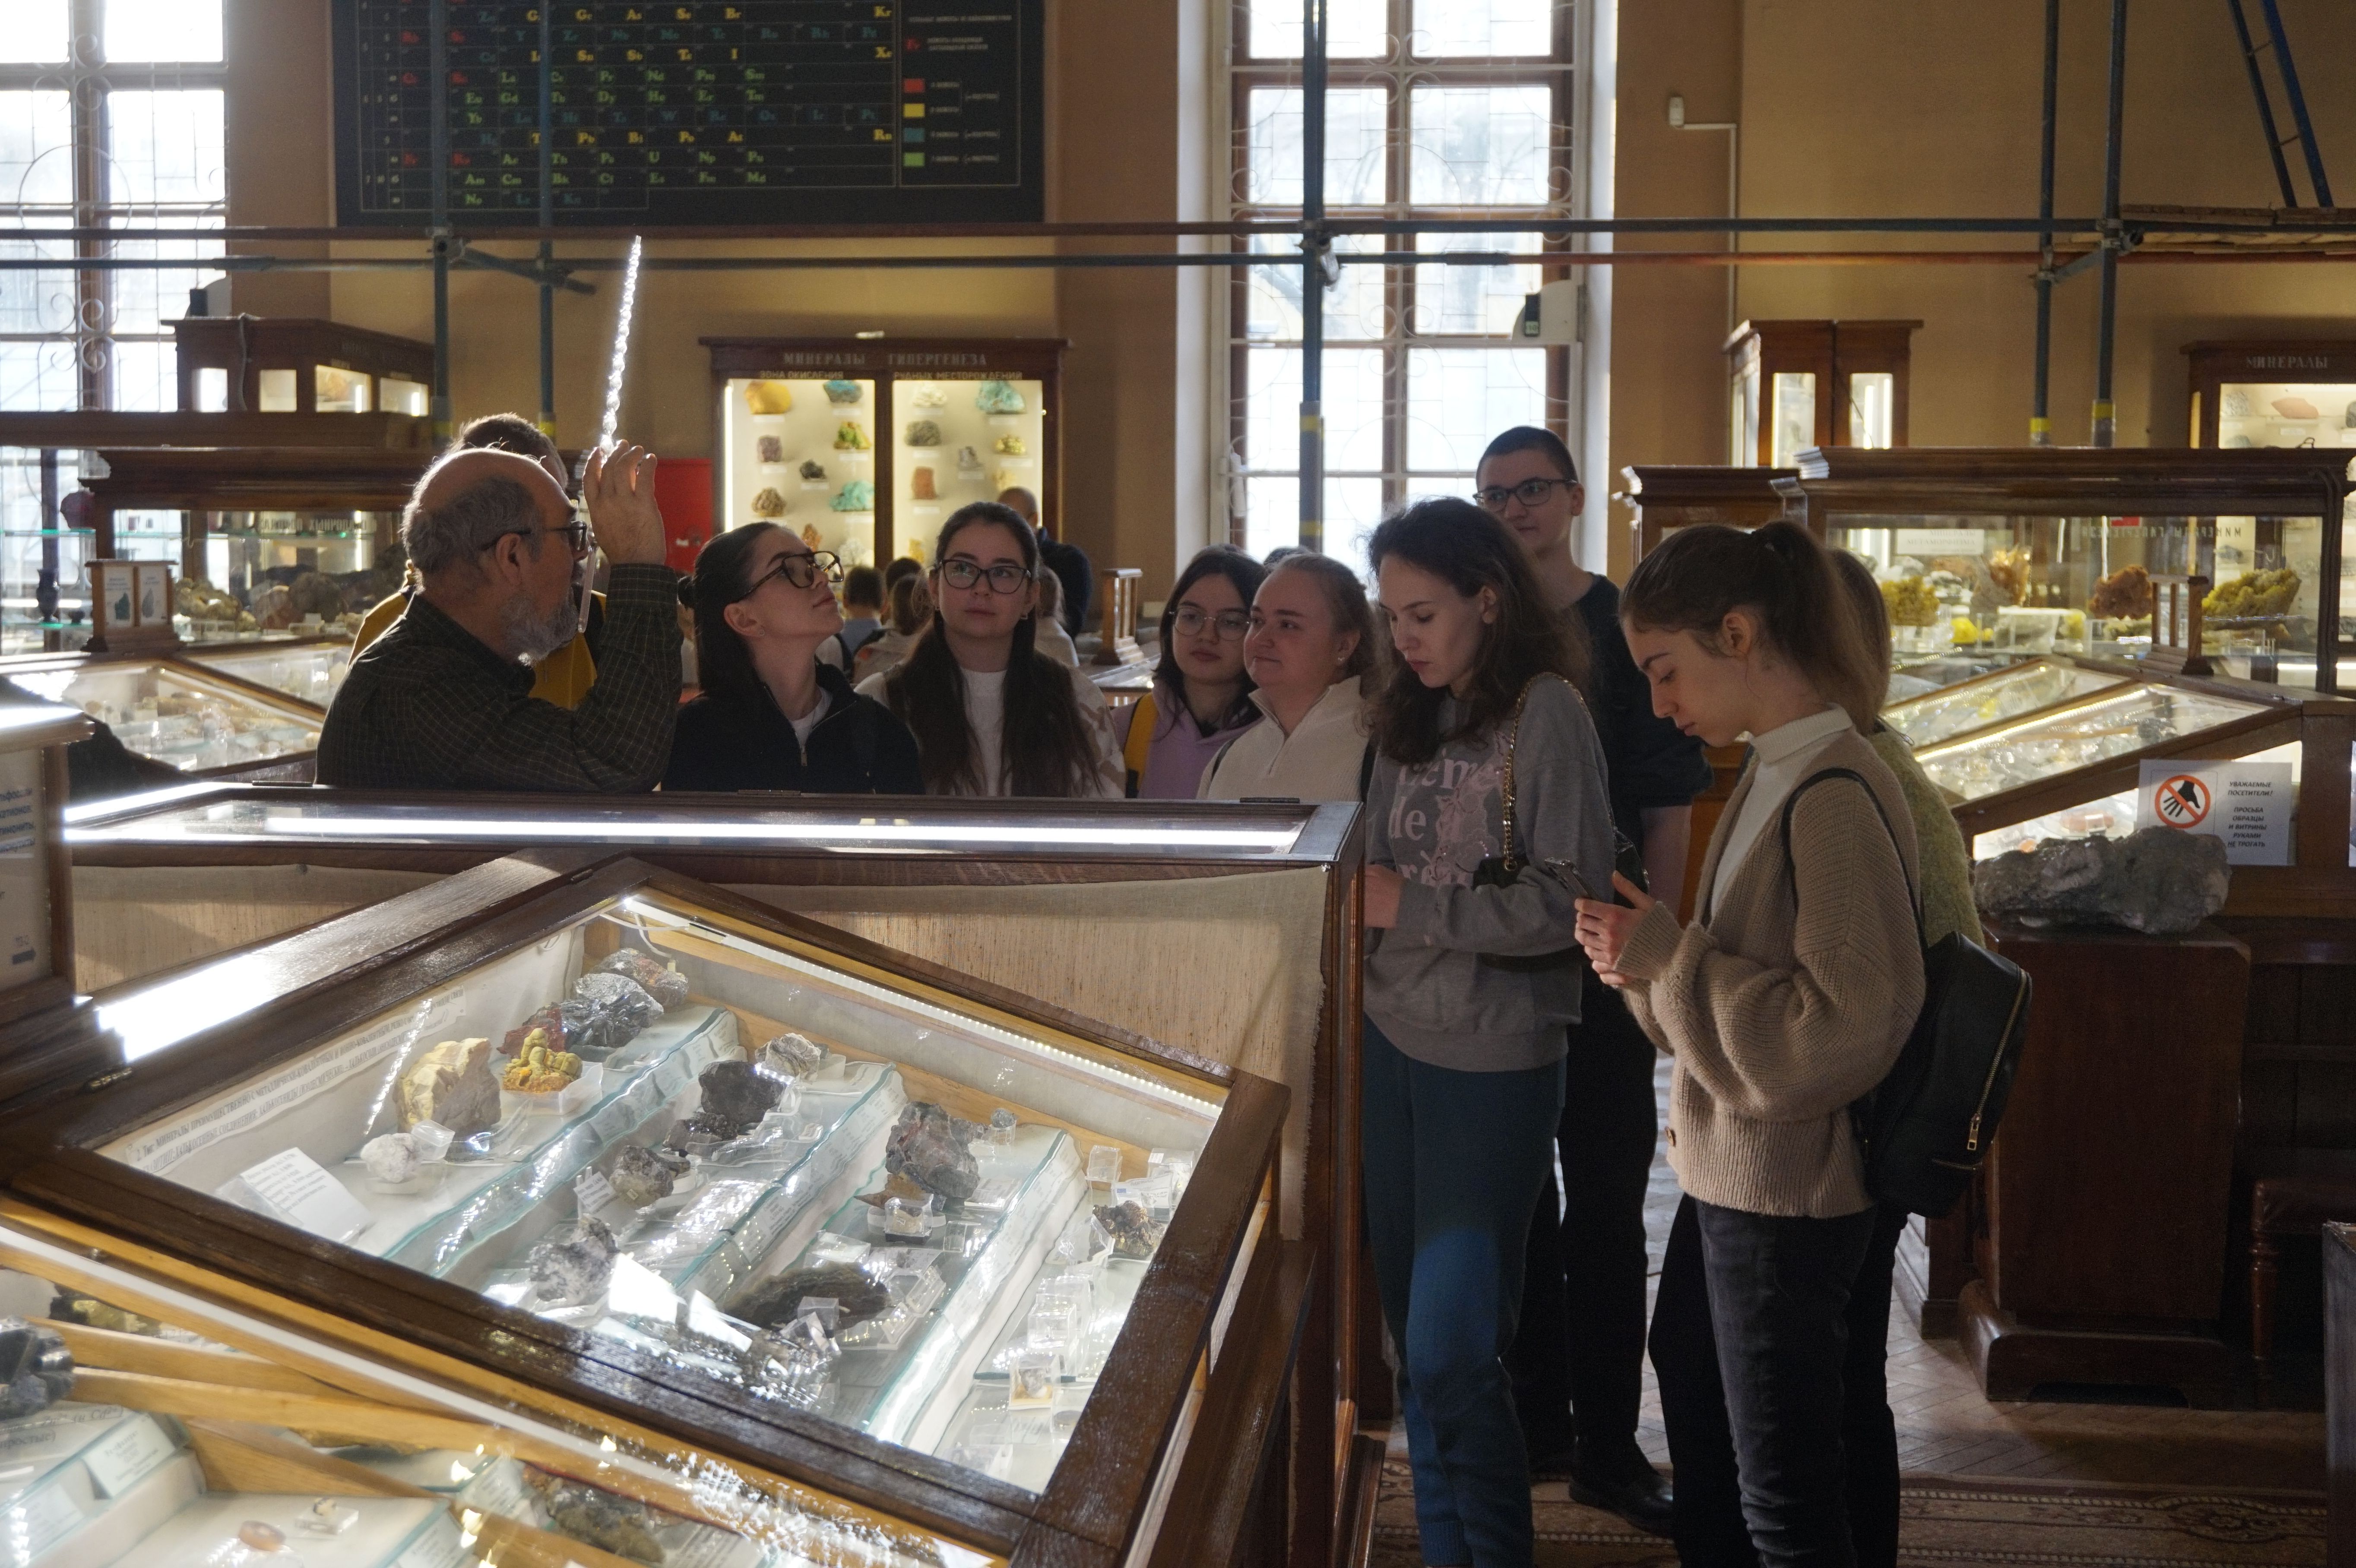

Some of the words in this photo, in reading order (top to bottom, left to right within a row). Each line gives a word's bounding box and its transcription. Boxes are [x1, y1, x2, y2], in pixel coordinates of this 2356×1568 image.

[527, 9, 540, 22] G
[725, 6, 741, 20] Br
[873, 5, 892, 18] Kr
[730, 47, 738, 60] I
[873, 129, 892, 142] Rn
[649, 151, 660, 163] U
[784, 353, 865, 365] МИНЕРАЛЫ
[888, 354, 987, 366] ГИПЕРГЕНЕЗА
[2246, 356, 2328, 369] МИНЕРАЛЫ
[760, 371, 785, 379] ЗОНА
[787, 371, 844, 380] ОКИСЛЕНИЯ
[893, 371, 934, 380] РУДНЫХ
[936, 371, 1023, 381] МЕСТОРОЖДЕНИЙ
